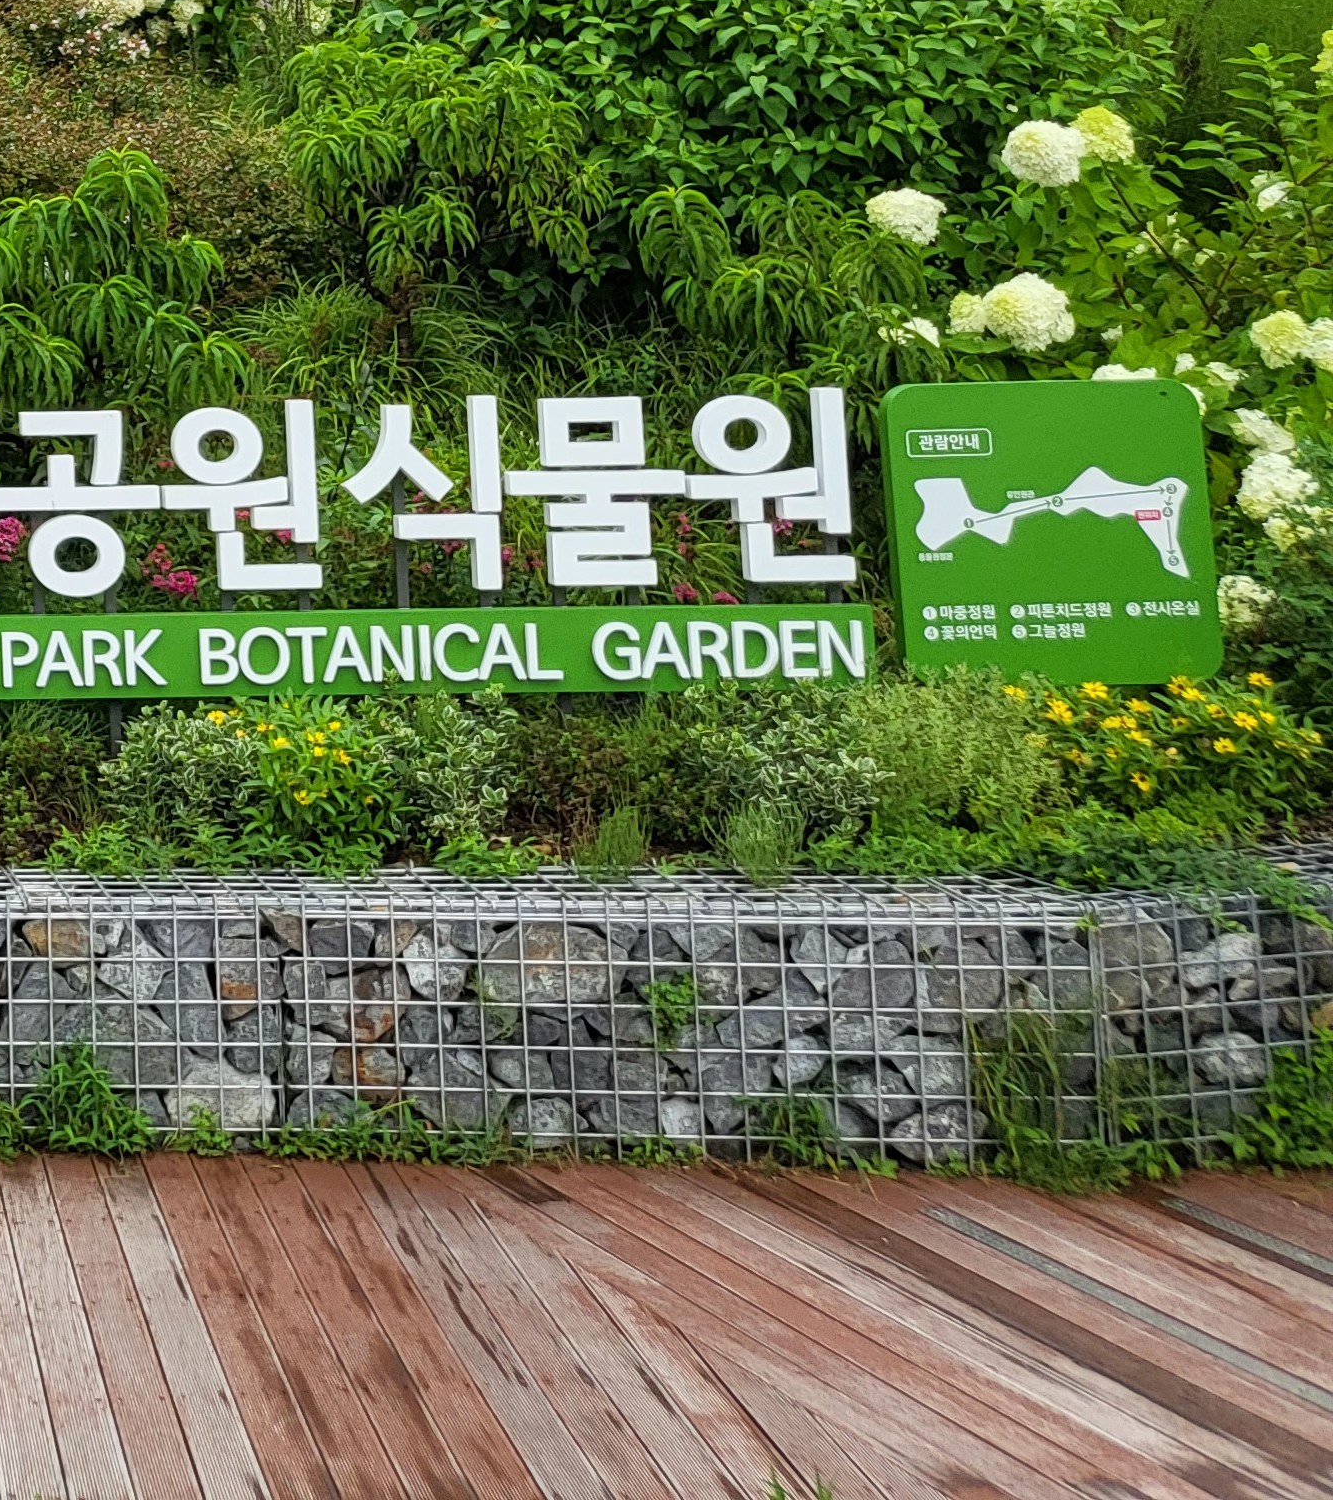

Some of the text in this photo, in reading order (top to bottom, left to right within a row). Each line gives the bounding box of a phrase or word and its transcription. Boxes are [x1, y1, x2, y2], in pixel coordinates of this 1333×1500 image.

[918, 433, 980, 451] 관람안내
[939, 604, 996, 621] 마중정원
[1027, 601, 1112, 619] 피톤치드정원
[1142, 600, 1200, 617] 전시온실
[941, 624, 998, 640] 꽃의언덕
[1028, 622, 1086, 638] 그늘정원
[0, 629, 169, 688] PARK
[199, 623, 564, 685] BOTANICAL
[591, 620, 866, 681] GARDEN
